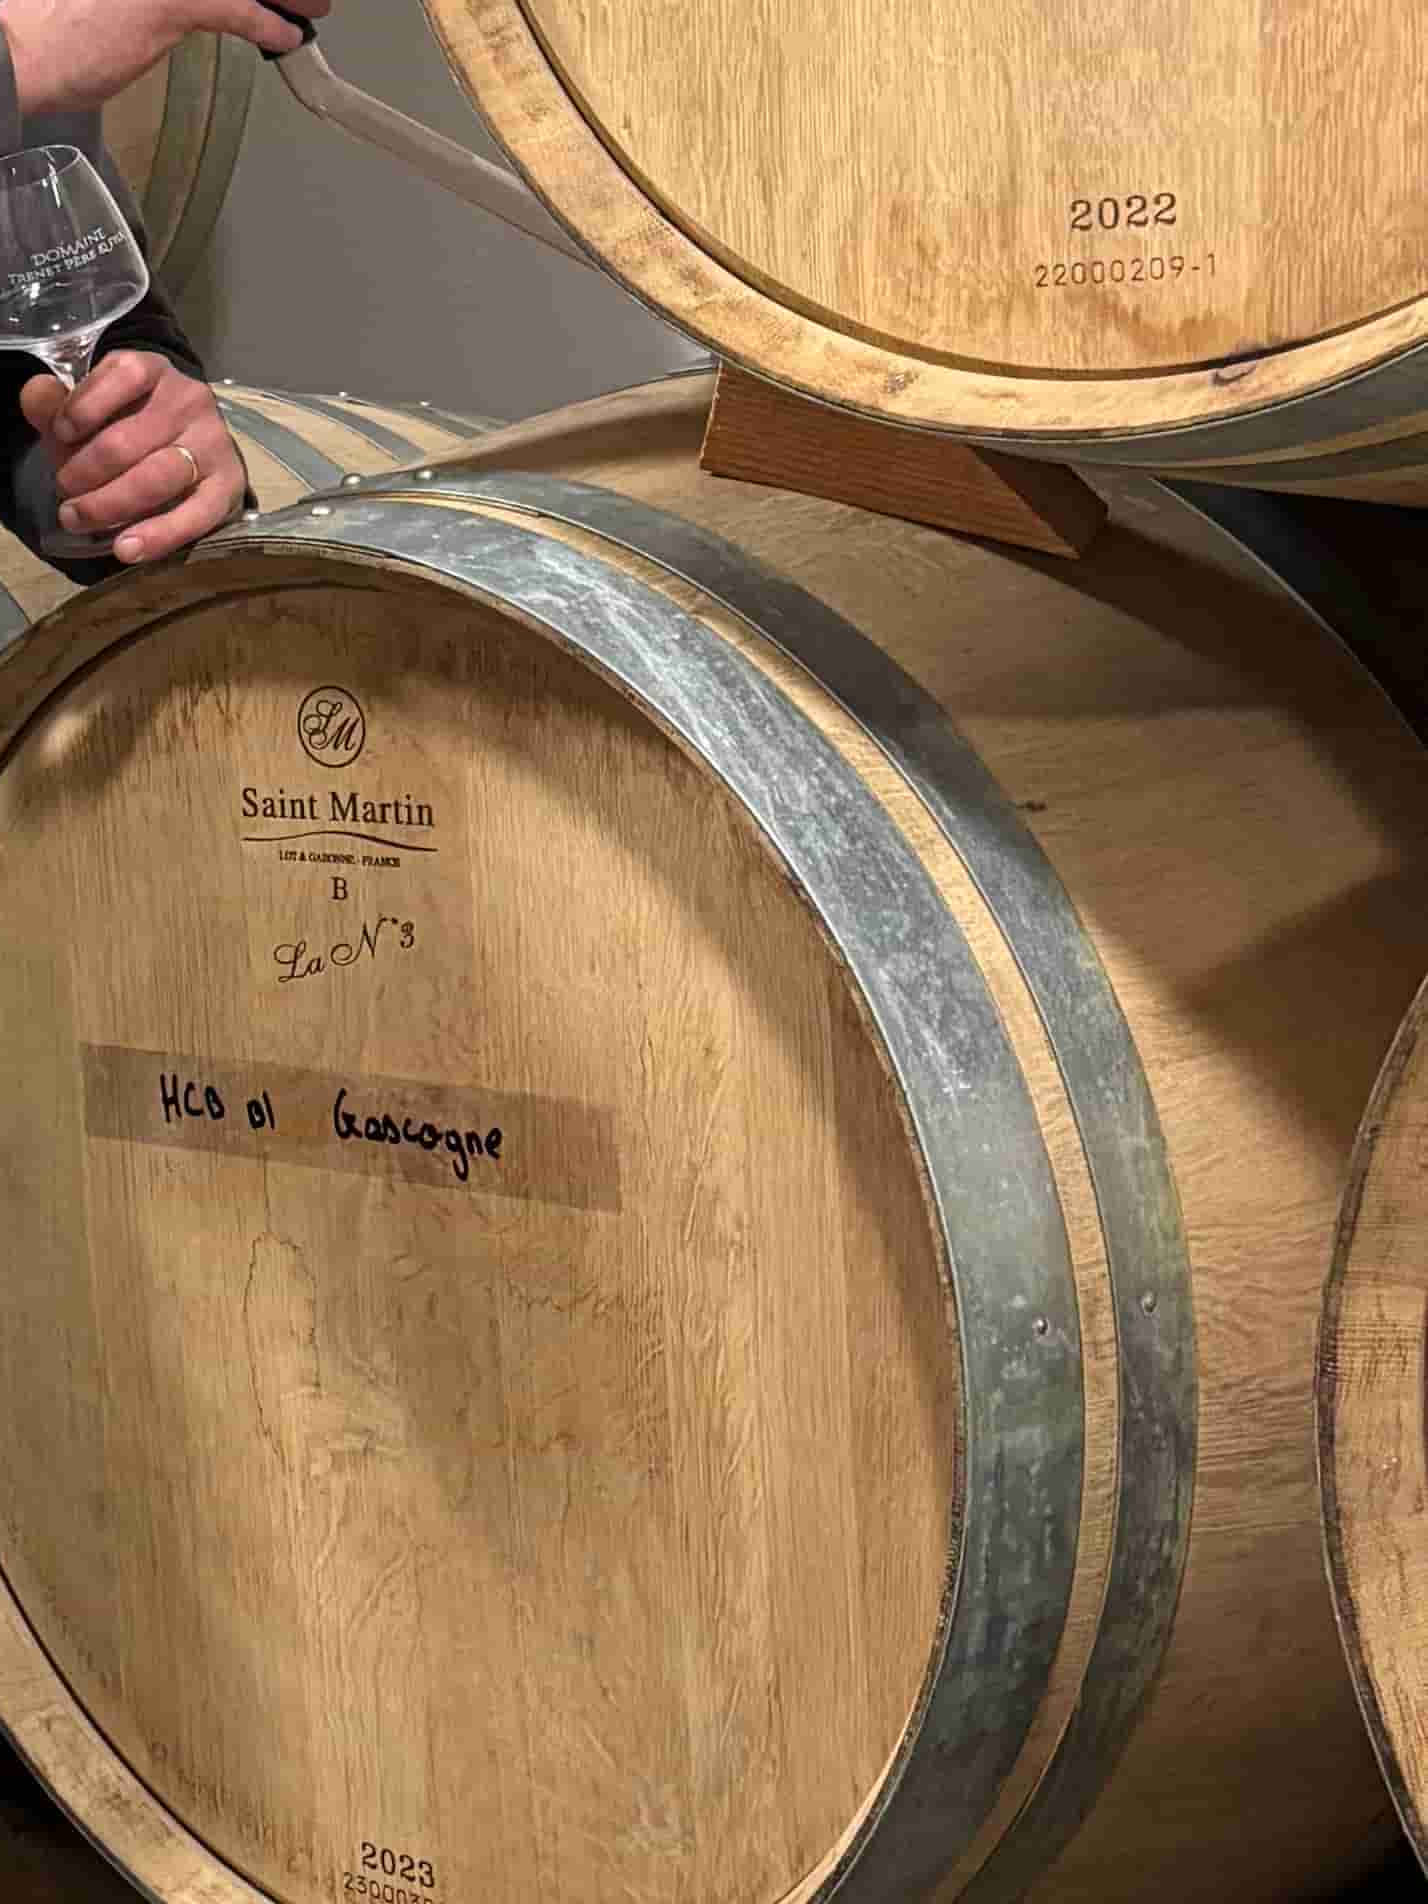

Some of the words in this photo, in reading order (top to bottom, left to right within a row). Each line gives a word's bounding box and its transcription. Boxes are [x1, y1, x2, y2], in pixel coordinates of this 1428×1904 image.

[1071, 192, 1177, 232] 2022
[1034, 252, 1217, 289] 22000209-1
[242, 787, 317, 822] Saint
[330, 791, 435, 828] Martin
[331, 876, 348, 900] B
[274, 941, 325, 983] La
[334, 1087, 503, 1181] Gascogne
[362, 1841, 435, 1888] 2023
